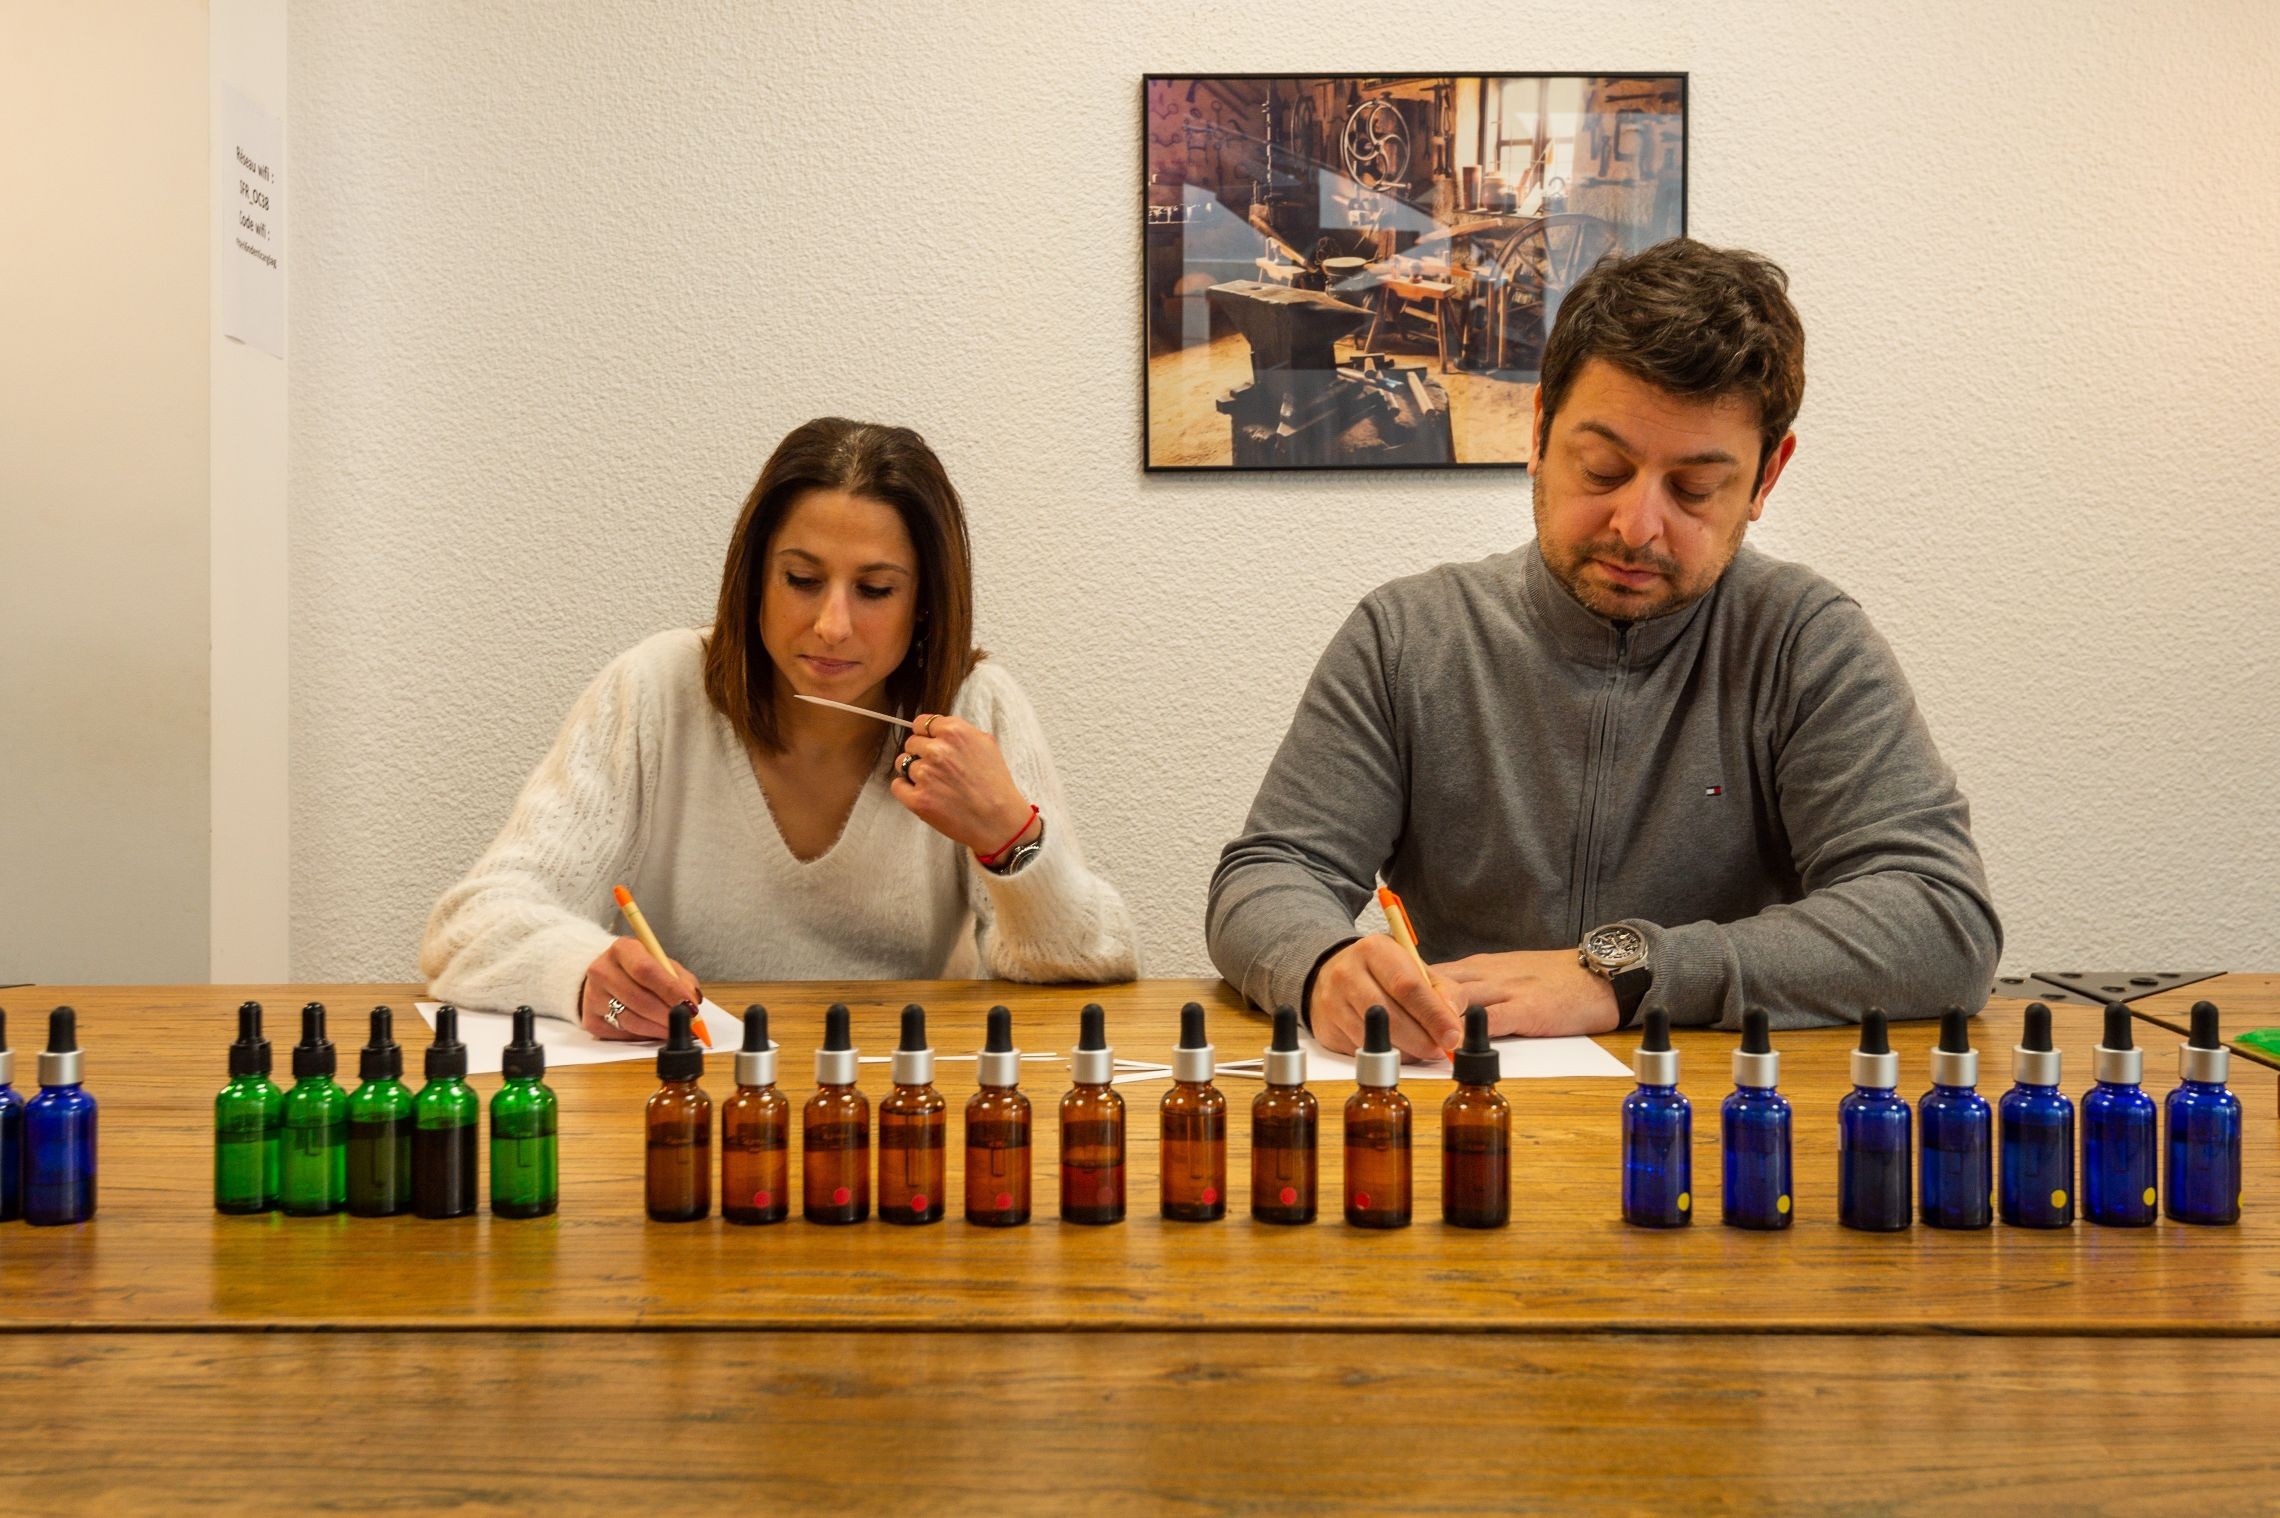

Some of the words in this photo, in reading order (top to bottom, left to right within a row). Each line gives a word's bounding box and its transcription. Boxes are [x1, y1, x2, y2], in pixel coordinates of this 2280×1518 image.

[258, 164, 270, 182] wifi
[239, 210, 254, 232] Code
[255, 222, 267, 239] wifi
